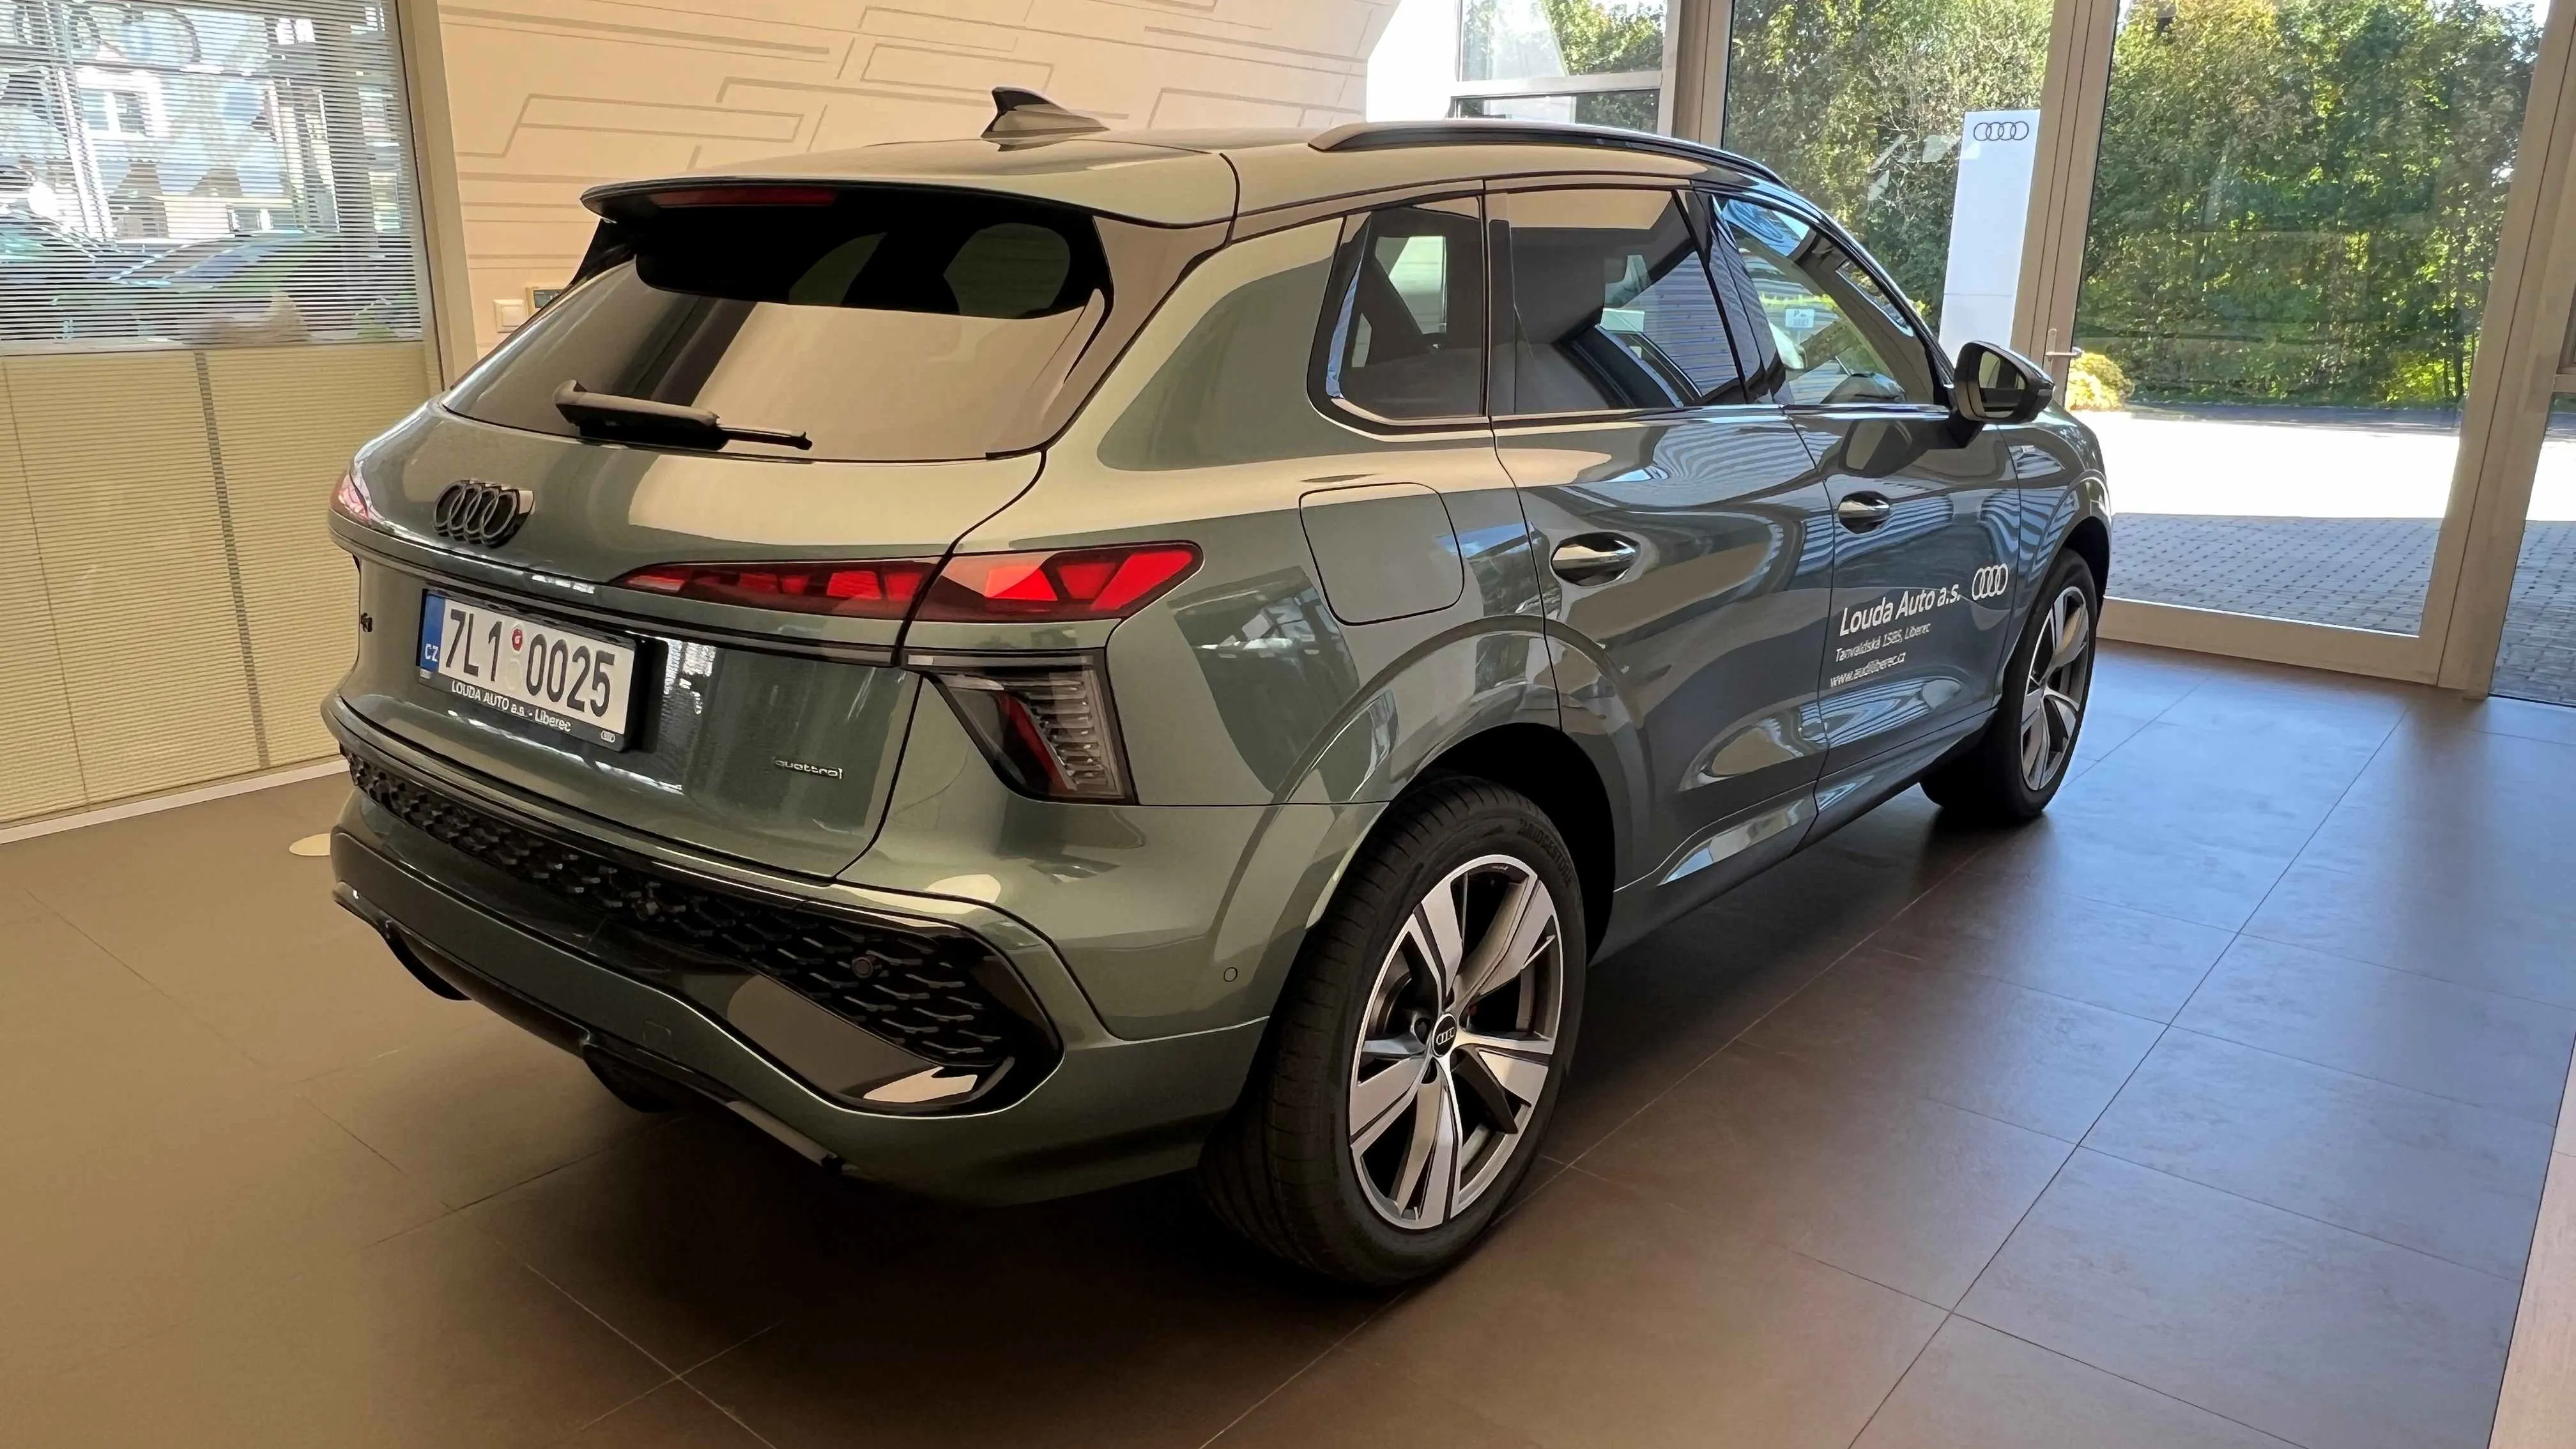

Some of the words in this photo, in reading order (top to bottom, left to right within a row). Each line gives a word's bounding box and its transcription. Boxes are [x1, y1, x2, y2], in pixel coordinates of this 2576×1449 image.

[1839, 596, 1894, 636] Louda
[1895, 589, 1935, 620] Auto
[1937, 584, 1961, 607] a.s.
[424, 643, 439, 662] CZ
[445, 608, 502, 682] 7L1
[526, 633, 615, 717] 0025
[452, 680, 481, 702] LOUDA
[483, 692, 510, 711] AUTO
[534, 709, 572, 732] Liberec
[774, 759, 843, 779] quattro
